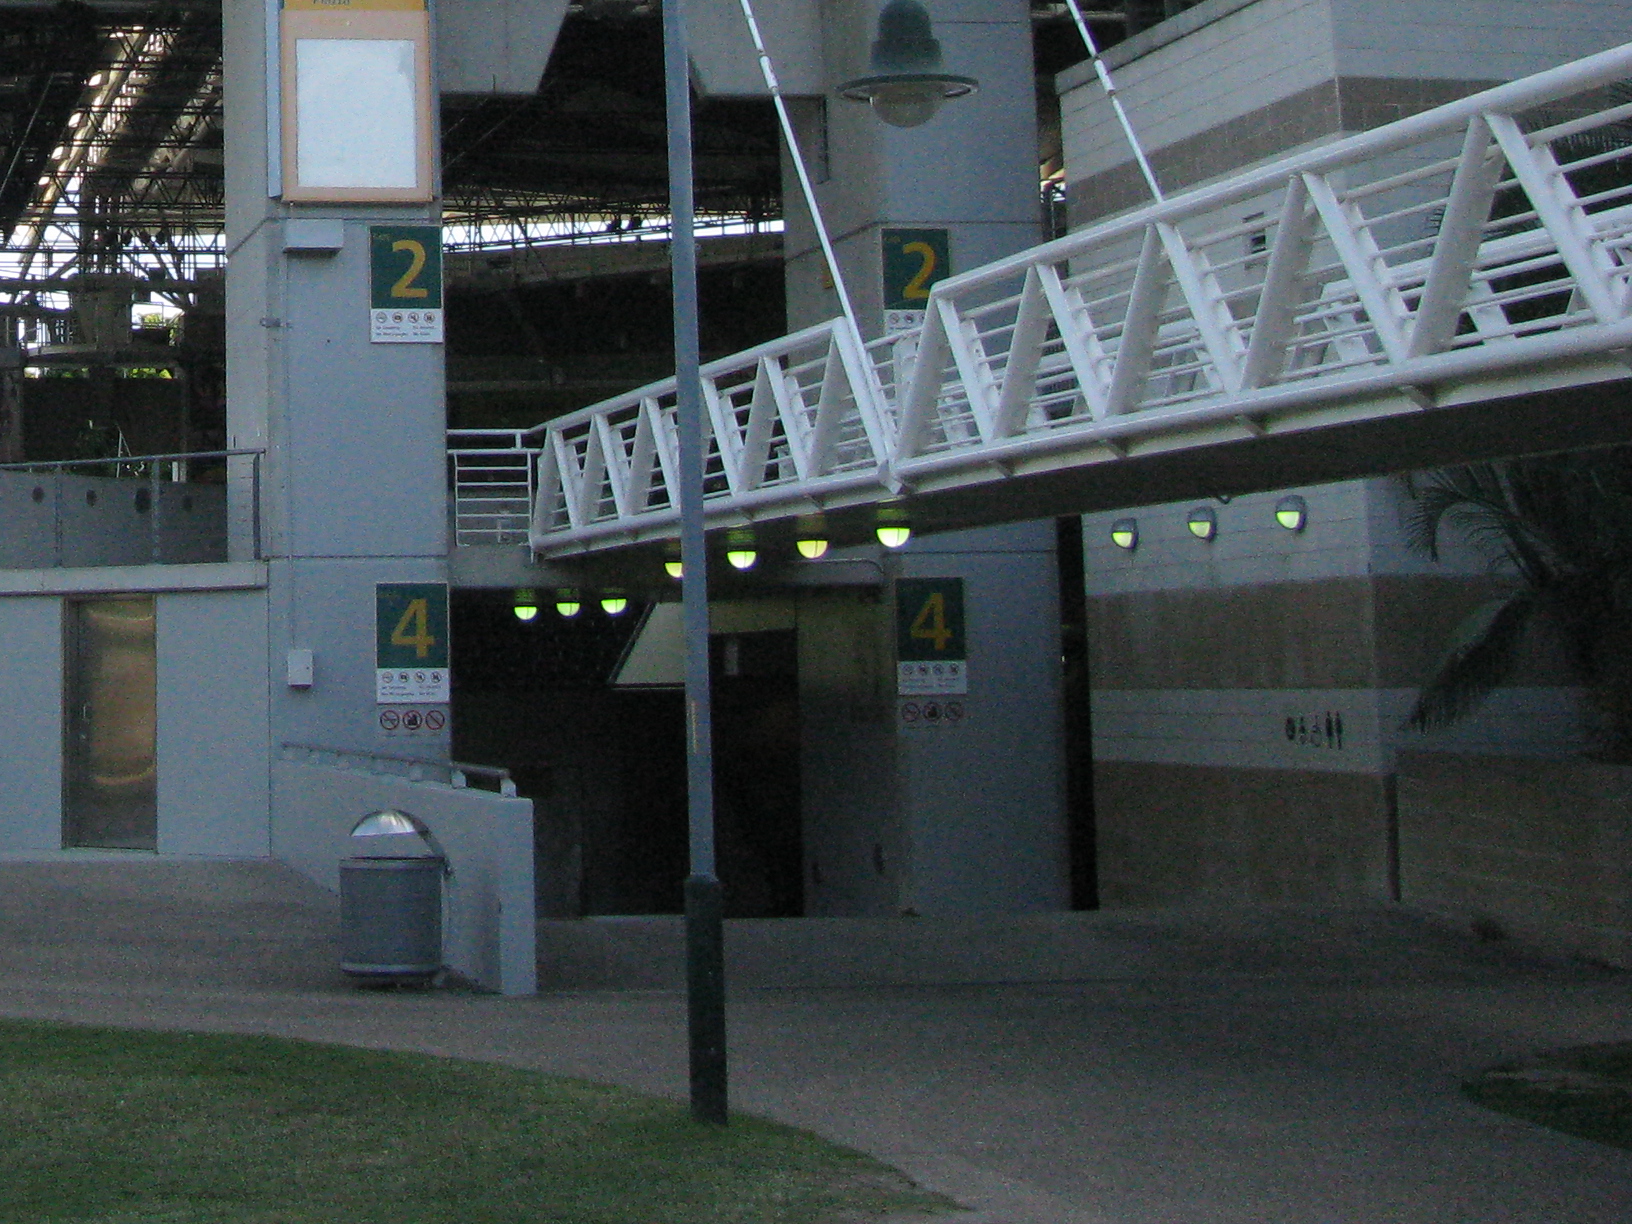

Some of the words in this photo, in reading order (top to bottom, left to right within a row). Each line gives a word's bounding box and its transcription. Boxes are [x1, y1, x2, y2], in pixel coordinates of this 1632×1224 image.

[390, 239, 428, 298] 2
[902, 241, 937, 299] 2
[390, 598, 435, 658] 4
[910, 592, 954, 651] 4
